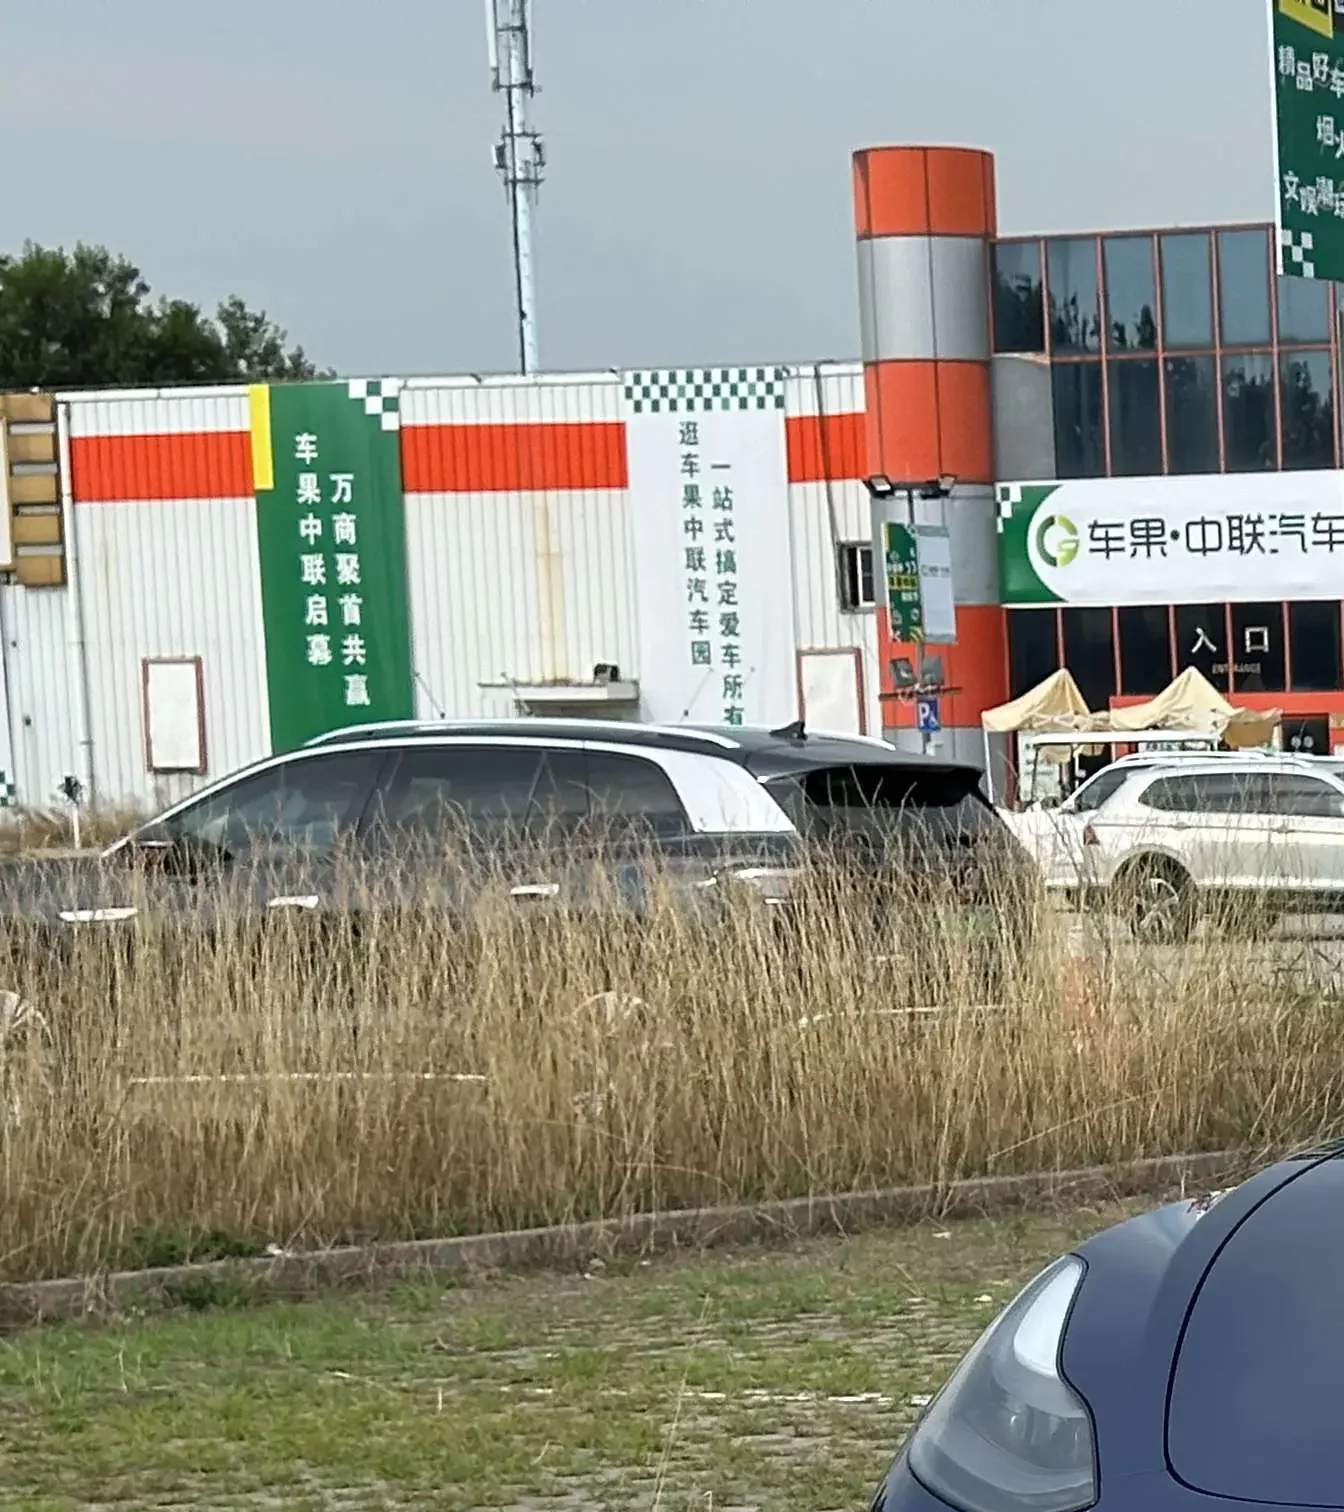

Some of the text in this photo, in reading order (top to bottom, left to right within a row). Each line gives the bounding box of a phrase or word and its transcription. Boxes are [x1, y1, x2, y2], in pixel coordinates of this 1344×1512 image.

[294, 432, 332, 666] 车果中联启幕
[330, 473, 370, 707] 万商聚首共赢
[679, 420, 712, 666] 逛车果中联汽车园
[1191, 626, 1269, 653] 入口
